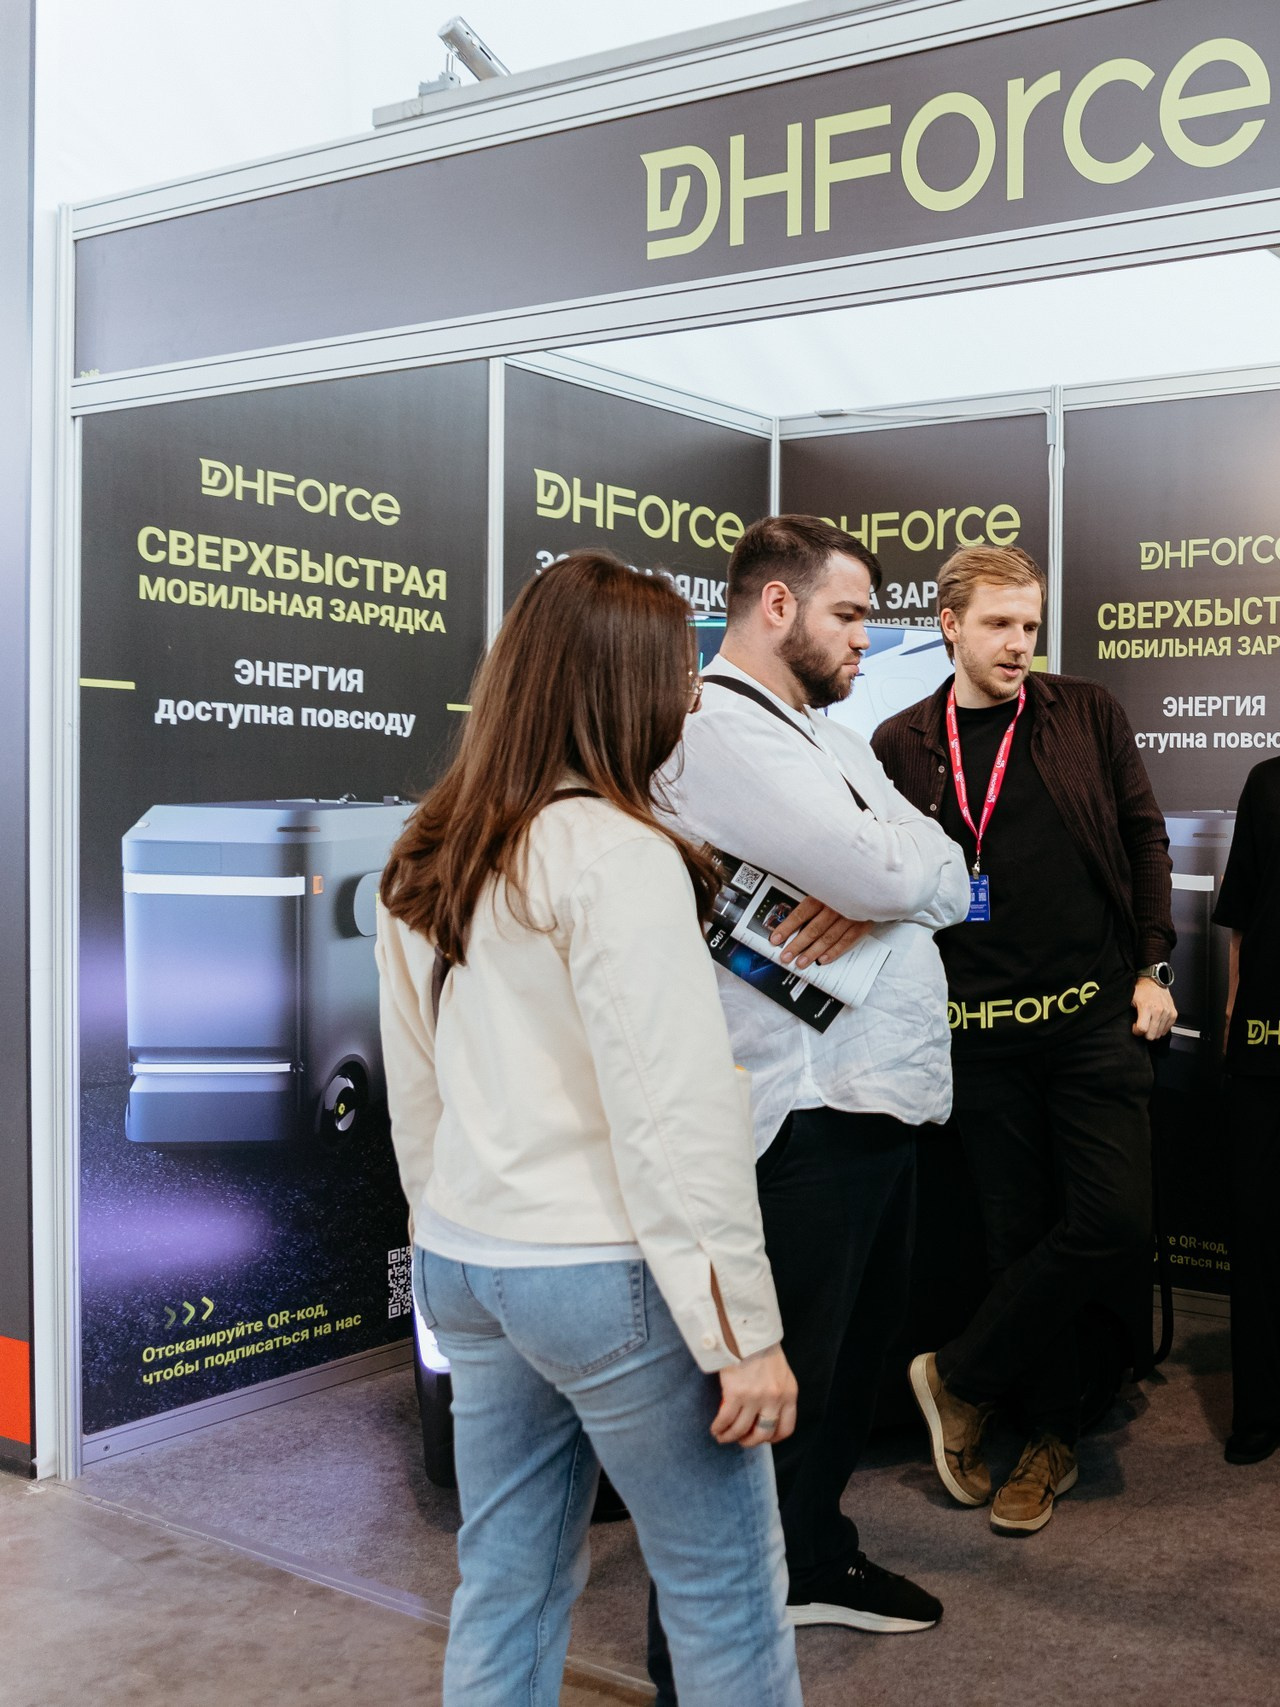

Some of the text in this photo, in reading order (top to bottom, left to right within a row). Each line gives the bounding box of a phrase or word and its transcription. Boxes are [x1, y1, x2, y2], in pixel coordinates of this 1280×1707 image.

[640, 38, 1271, 260] DHForce
[199, 457, 401, 526] DHForce
[819, 504, 1021, 554] HForce
[136, 525, 448, 600] СВЕРХБЫСТРАЯ
[138, 574, 447, 634] МОБИЛЬНАЯ ЗАРЯДКА
[1098, 636, 1231, 660] МОБИЛЬНАЯ
[234, 658, 365, 694] ЭНЕРГИЯ
[154, 697, 416, 738] доступна повсюду
[1162, 695, 1266, 717] ЭНЕРГИЯ
[1134, 731, 1207, 753] ступна
[1170, 1254, 1213, 1268] саться
[142, 1303, 328, 1363] Отсканируйте QR-код,
[142, 1315, 362, 1386] чтобы подписаться на нас
